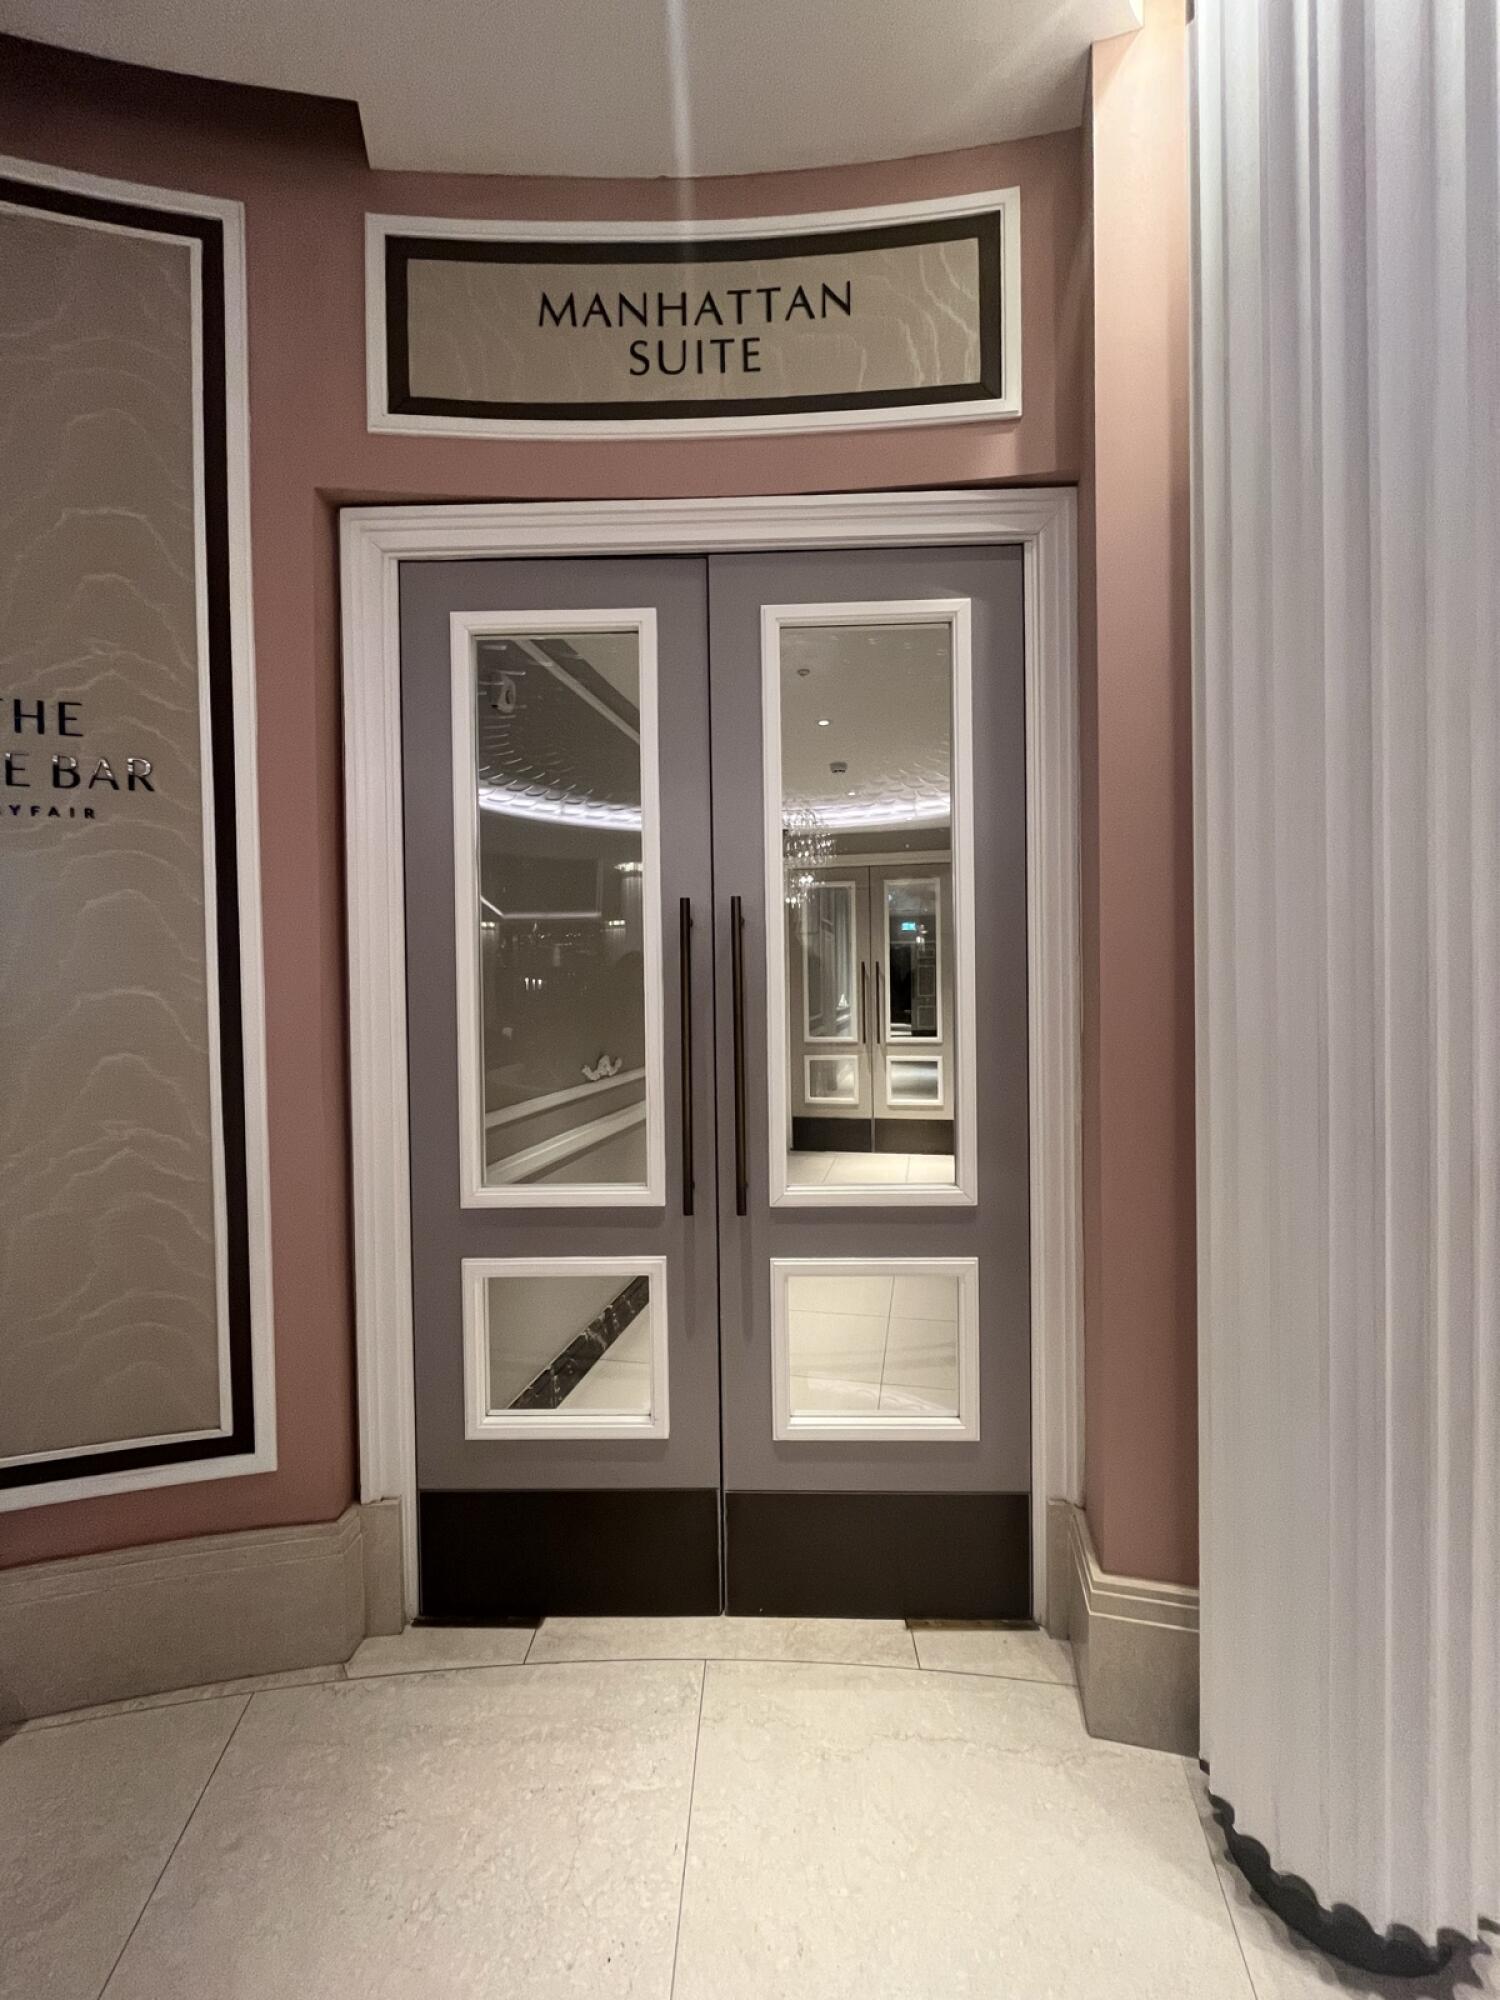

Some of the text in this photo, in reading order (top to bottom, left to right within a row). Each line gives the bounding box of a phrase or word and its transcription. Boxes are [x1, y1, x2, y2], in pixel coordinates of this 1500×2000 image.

[538, 281, 851, 327] MANHATTAN
[629, 337, 761, 376] SUITE
[0, 698, 84, 737] HE
[52, 755, 155, 792] BAR
[0, 805, 95, 819] YFAIR
